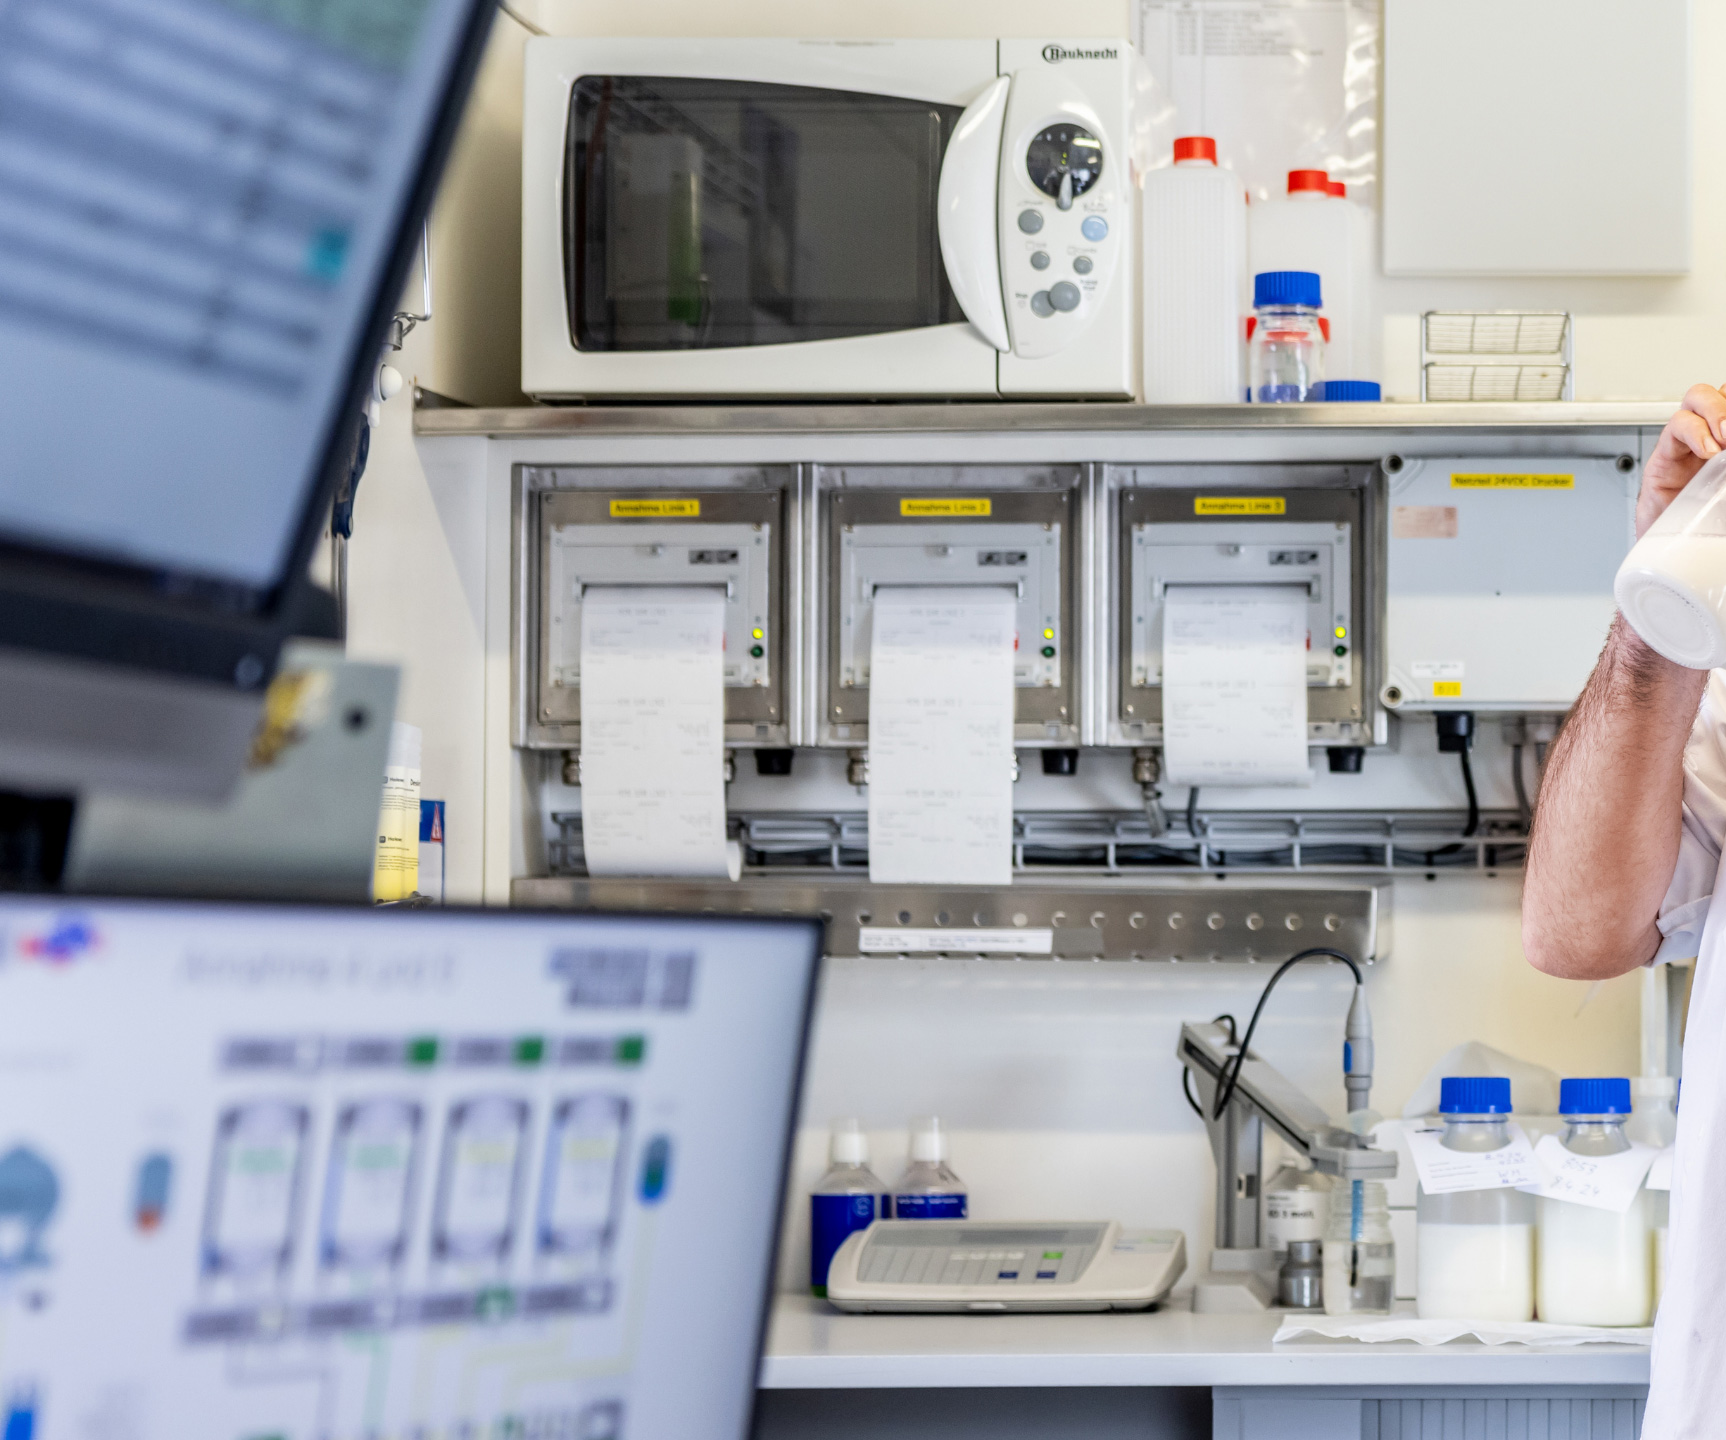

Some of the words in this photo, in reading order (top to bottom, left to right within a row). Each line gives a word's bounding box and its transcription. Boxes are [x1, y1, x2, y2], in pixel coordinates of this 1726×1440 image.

[616, 503, 659, 513] Annahme
[662, 504, 685, 513] Linie
[906, 503, 950, 512] Annahme
[954, 503, 976, 513] Linie
[1201, 502, 1245, 511] Annahme
[1248, 502, 1271, 511] Linie
